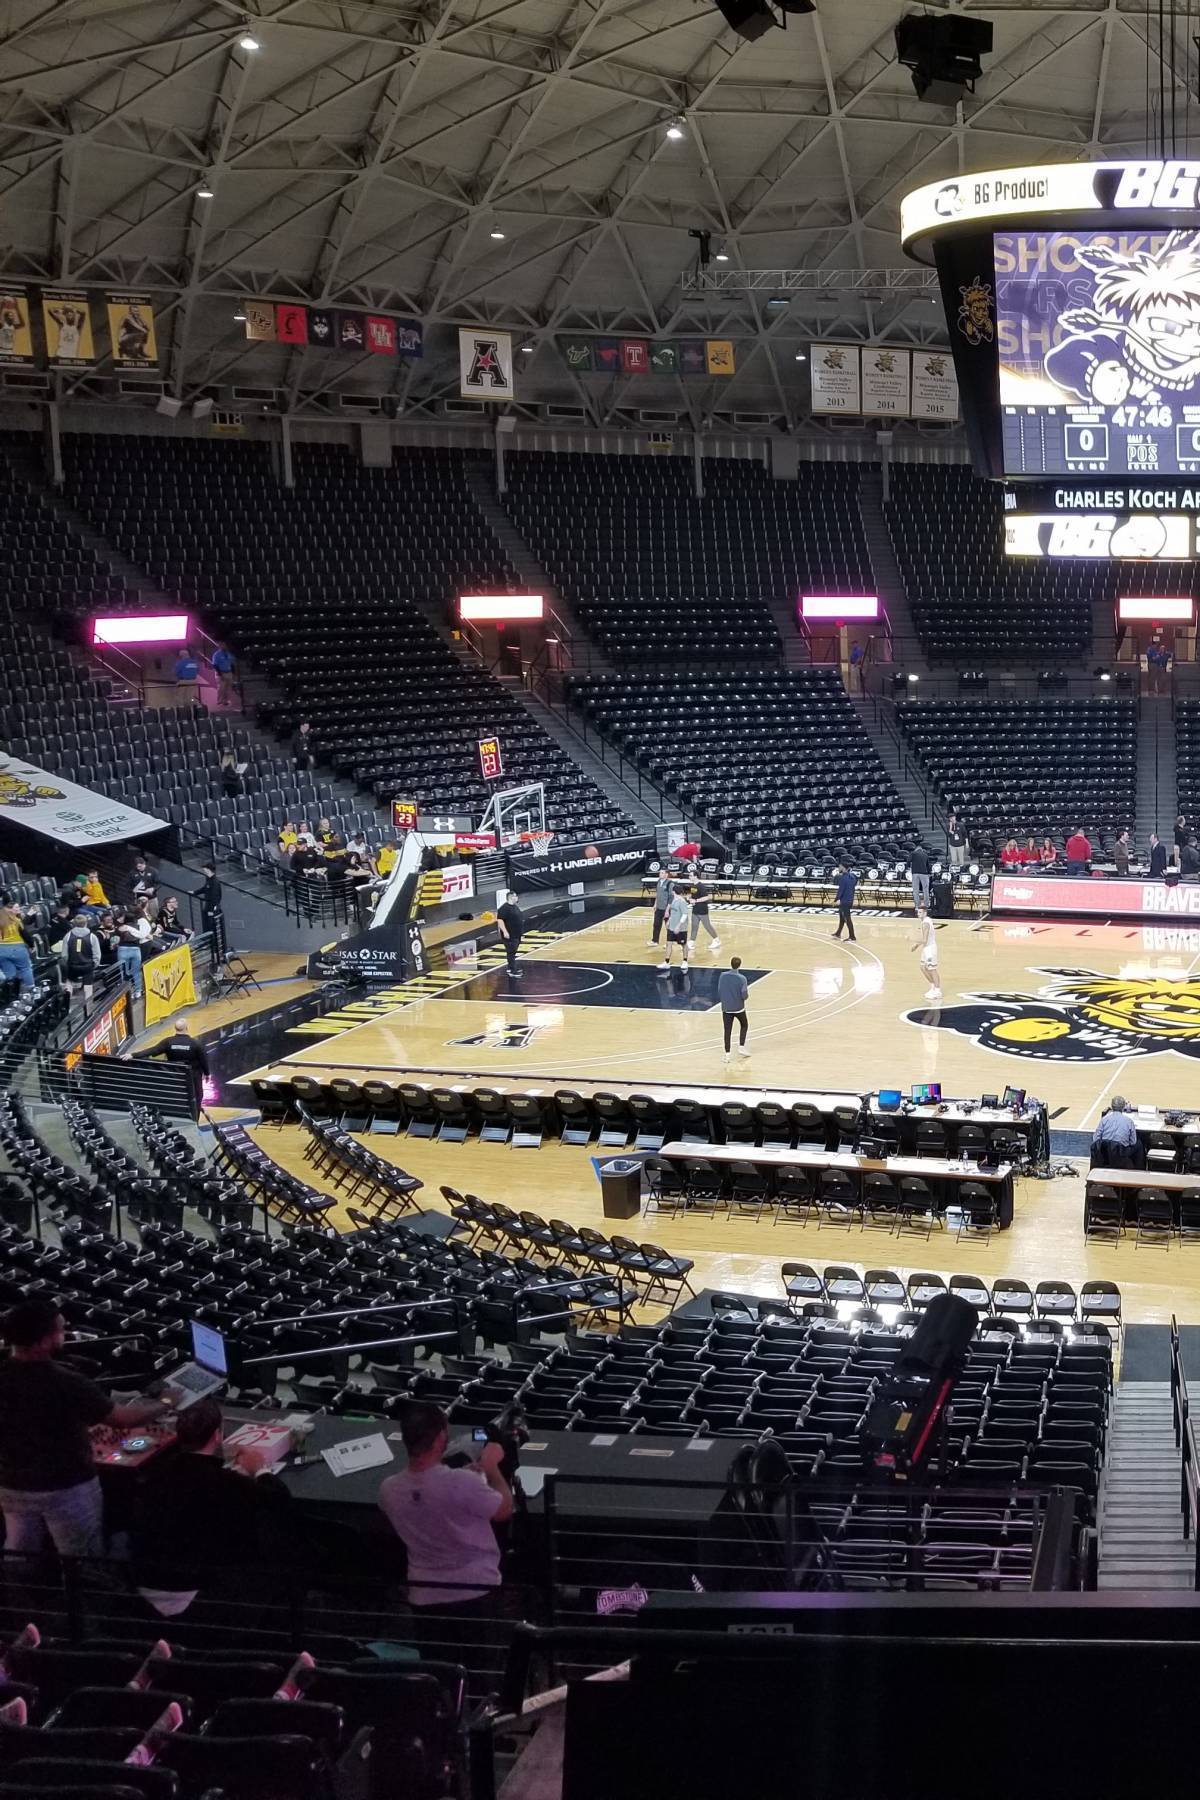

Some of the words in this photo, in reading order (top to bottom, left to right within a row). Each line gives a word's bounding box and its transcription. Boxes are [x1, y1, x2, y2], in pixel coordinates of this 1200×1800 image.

[975, 184, 990, 204] BG
[826, 398, 845, 406] 2013
[877, 401, 895, 409] 2014
[926, 404, 944, 413] 2015
[1110, 405, 1174, 428] 47:46
[1079, 429, 1095, 451] 0
[1127, 445, 1159, 462] POS
[1055, 489, 1125, 509] CHARLES
[1128, 489, 1177, 509] KOCH
[52, 814, 129, 834] Commerce
[398, 814, 413, 824] 23
[84, 826, 125, 838] Bank
[515, 868, 541, 877] POWERED
[564, 857, 602, 869] UNDER
[371, 950, 397, 960] STAR
[1066, 1028, 1148, 1056] WSU
